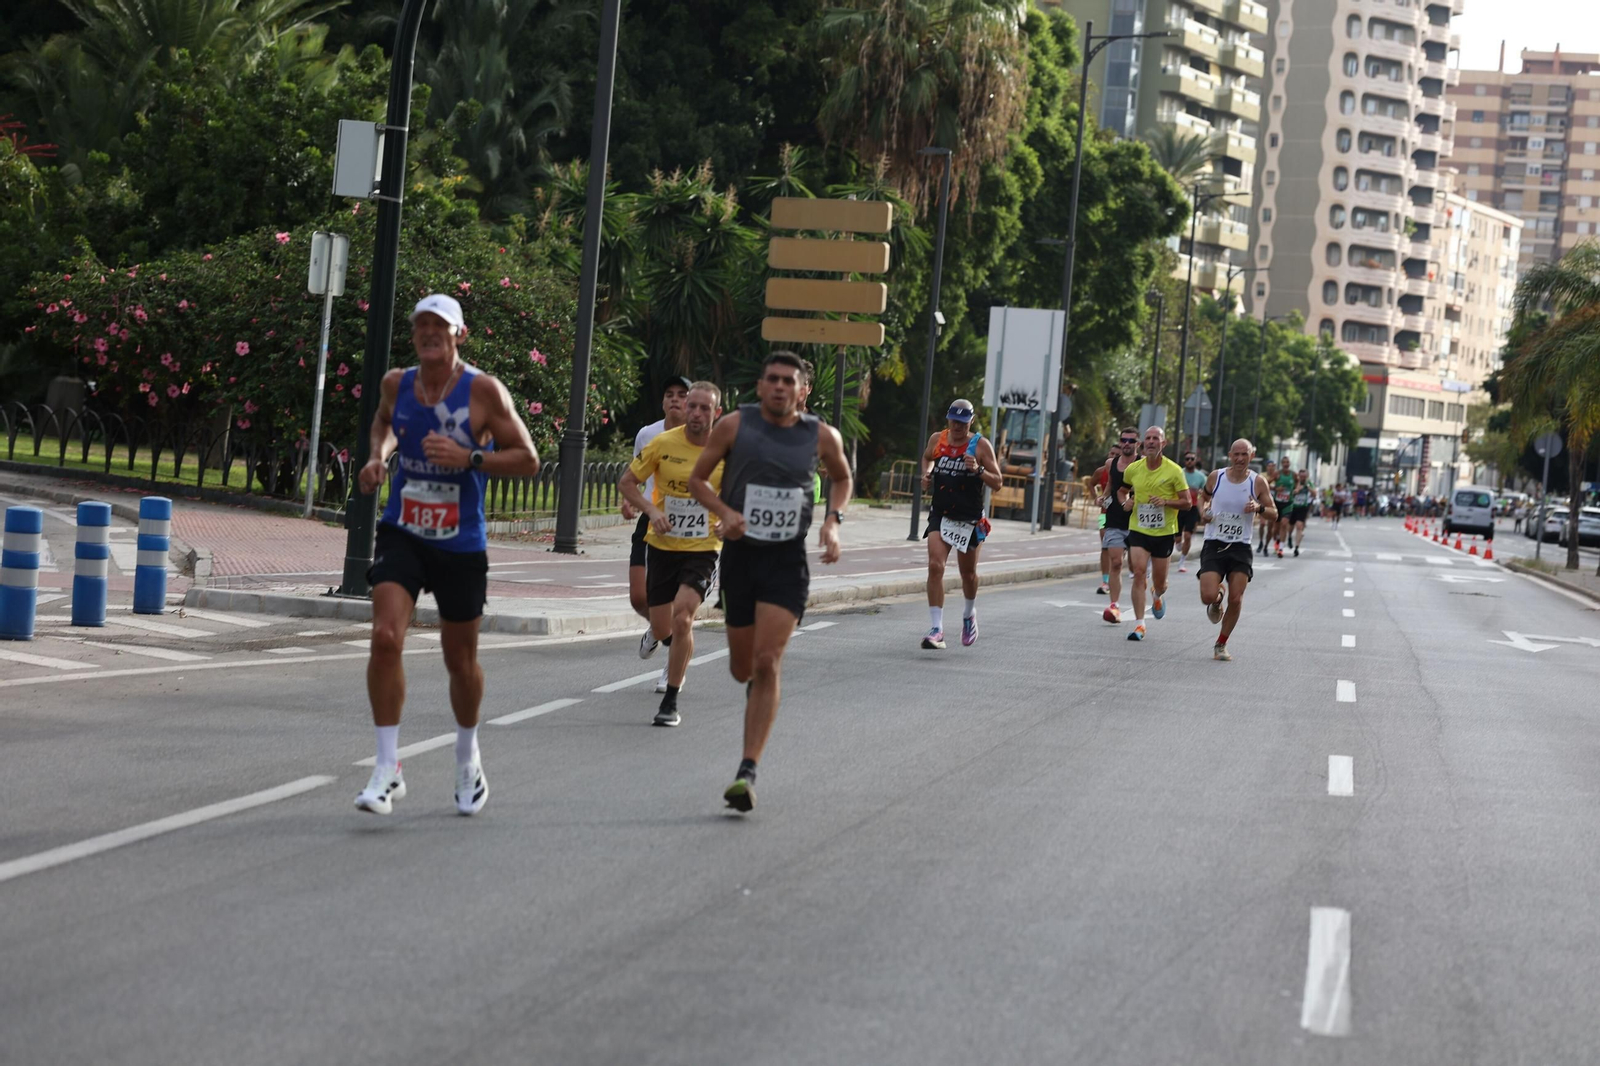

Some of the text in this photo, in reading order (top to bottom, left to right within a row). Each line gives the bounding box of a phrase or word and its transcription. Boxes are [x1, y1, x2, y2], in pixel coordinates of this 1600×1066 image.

[411, 505, 448, 530] 187
[668, 513, 706, 529] 8724
[749, 508, 797, 528] 5932
[1139, 513, 1164, 523] 8126
[943, 528, 967, 547] 2488
